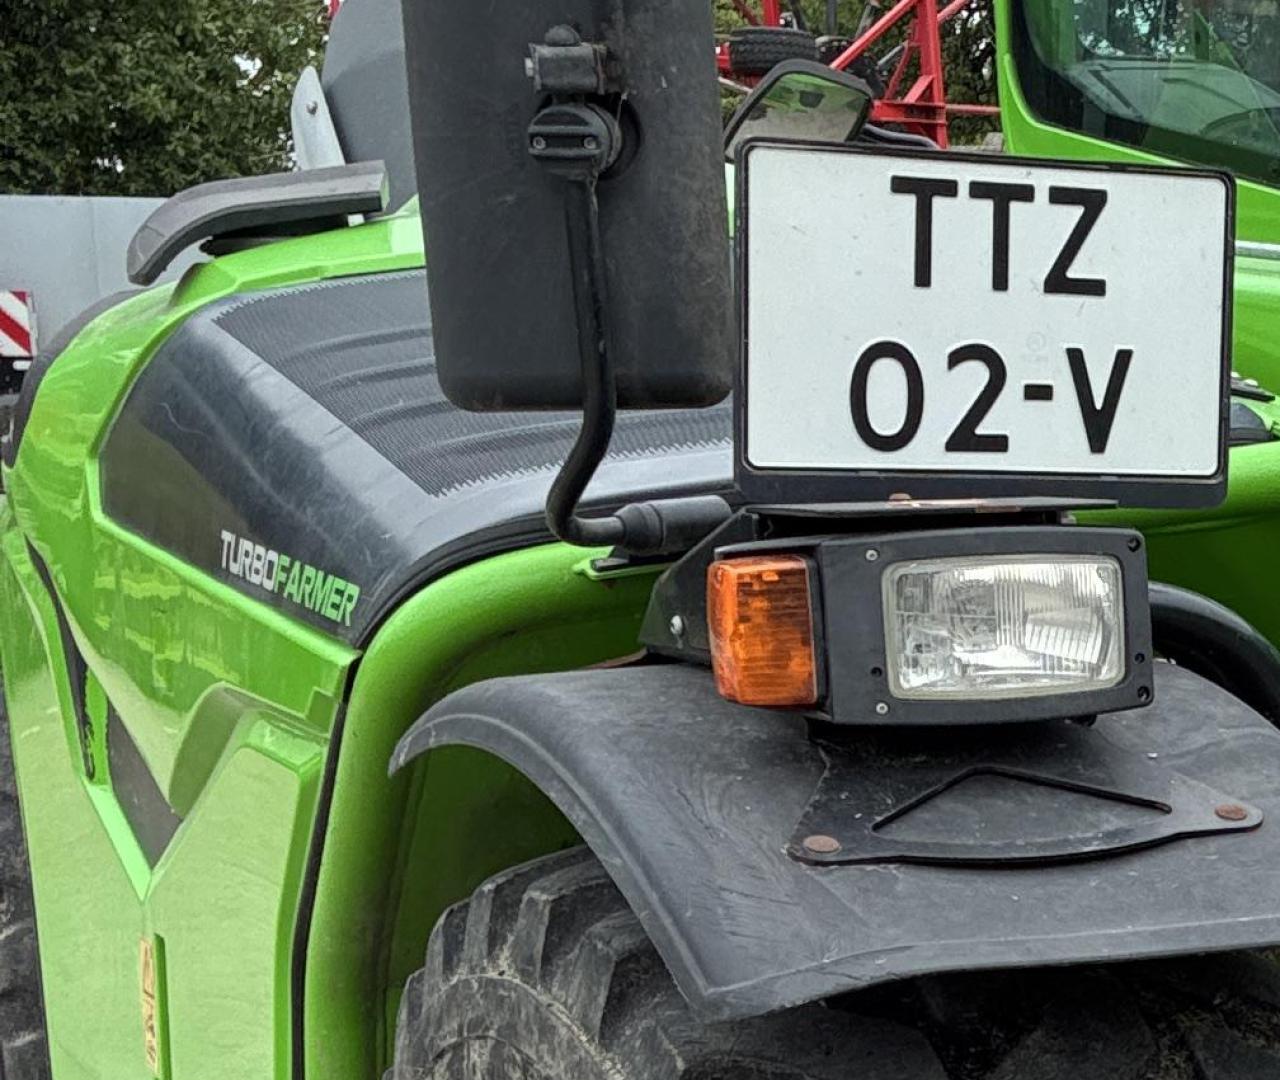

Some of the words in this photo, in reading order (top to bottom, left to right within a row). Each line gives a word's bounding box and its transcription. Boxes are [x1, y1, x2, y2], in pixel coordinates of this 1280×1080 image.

[890, 175, 1108, 297] TTZ
[850, 340, 1134, 454] 02-V
[221, 529, 360, 627] TURBOFARMER
